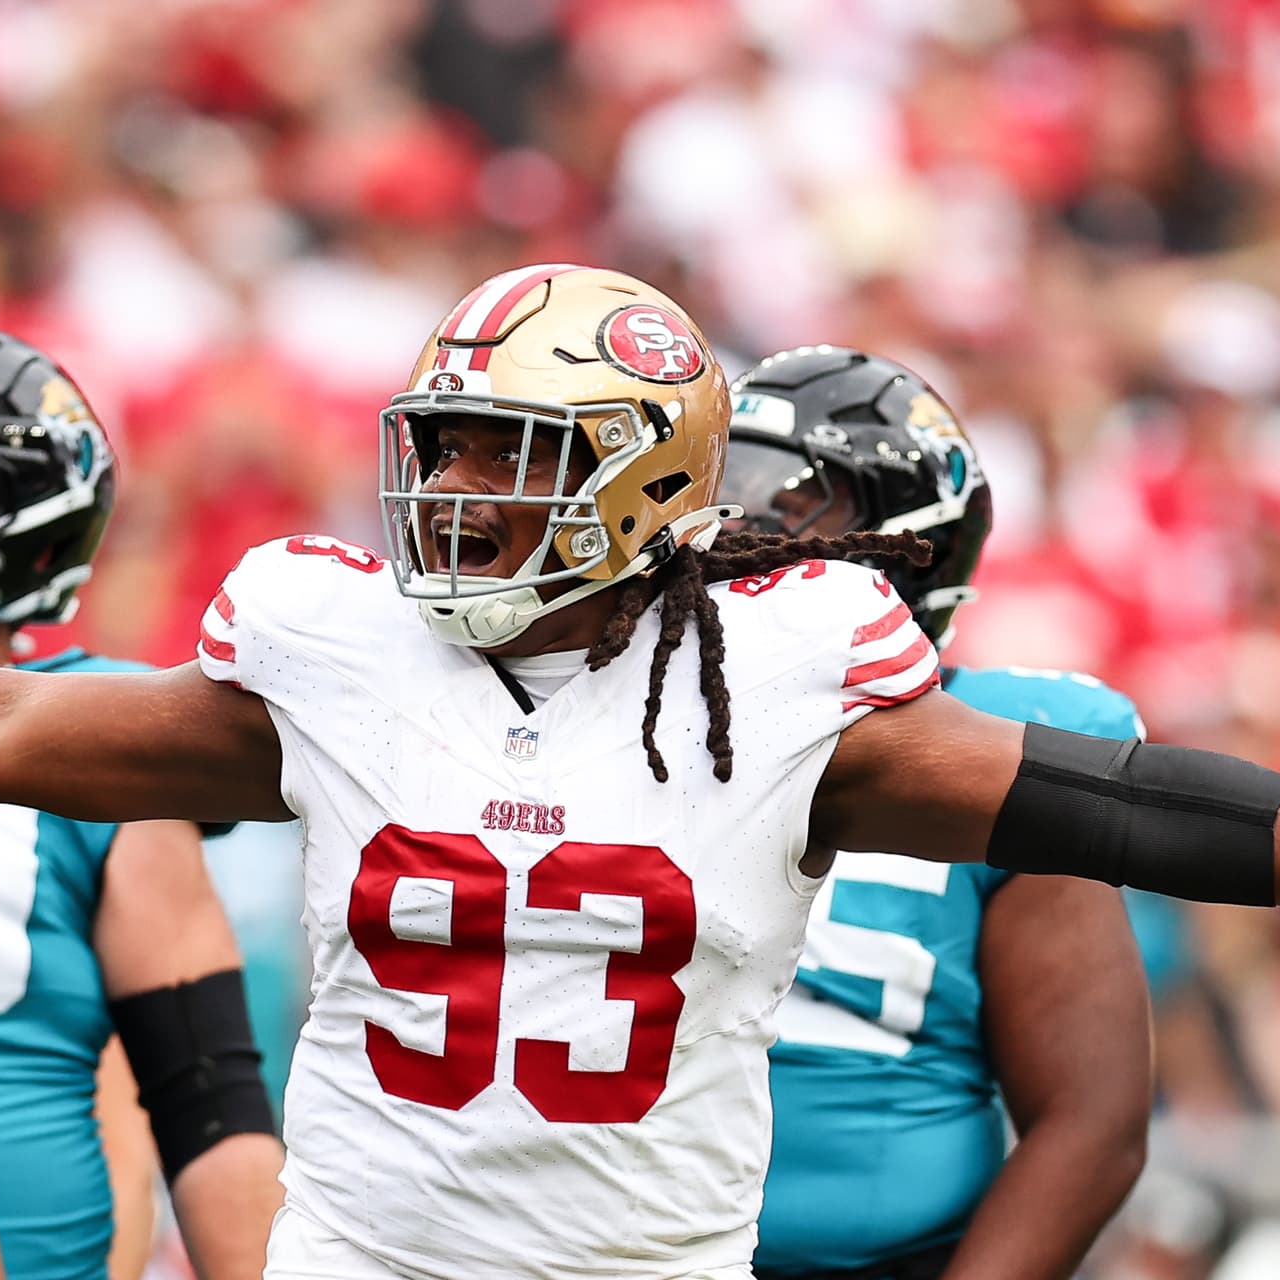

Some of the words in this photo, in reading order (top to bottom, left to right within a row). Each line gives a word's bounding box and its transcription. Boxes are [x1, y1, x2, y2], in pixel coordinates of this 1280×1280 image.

[625, 311, 691, 379] SF
[508, 738, 534, 755] NFL
[480, 799, 566, 835] 49ERS
[347, 822, 698, 1124] 93
